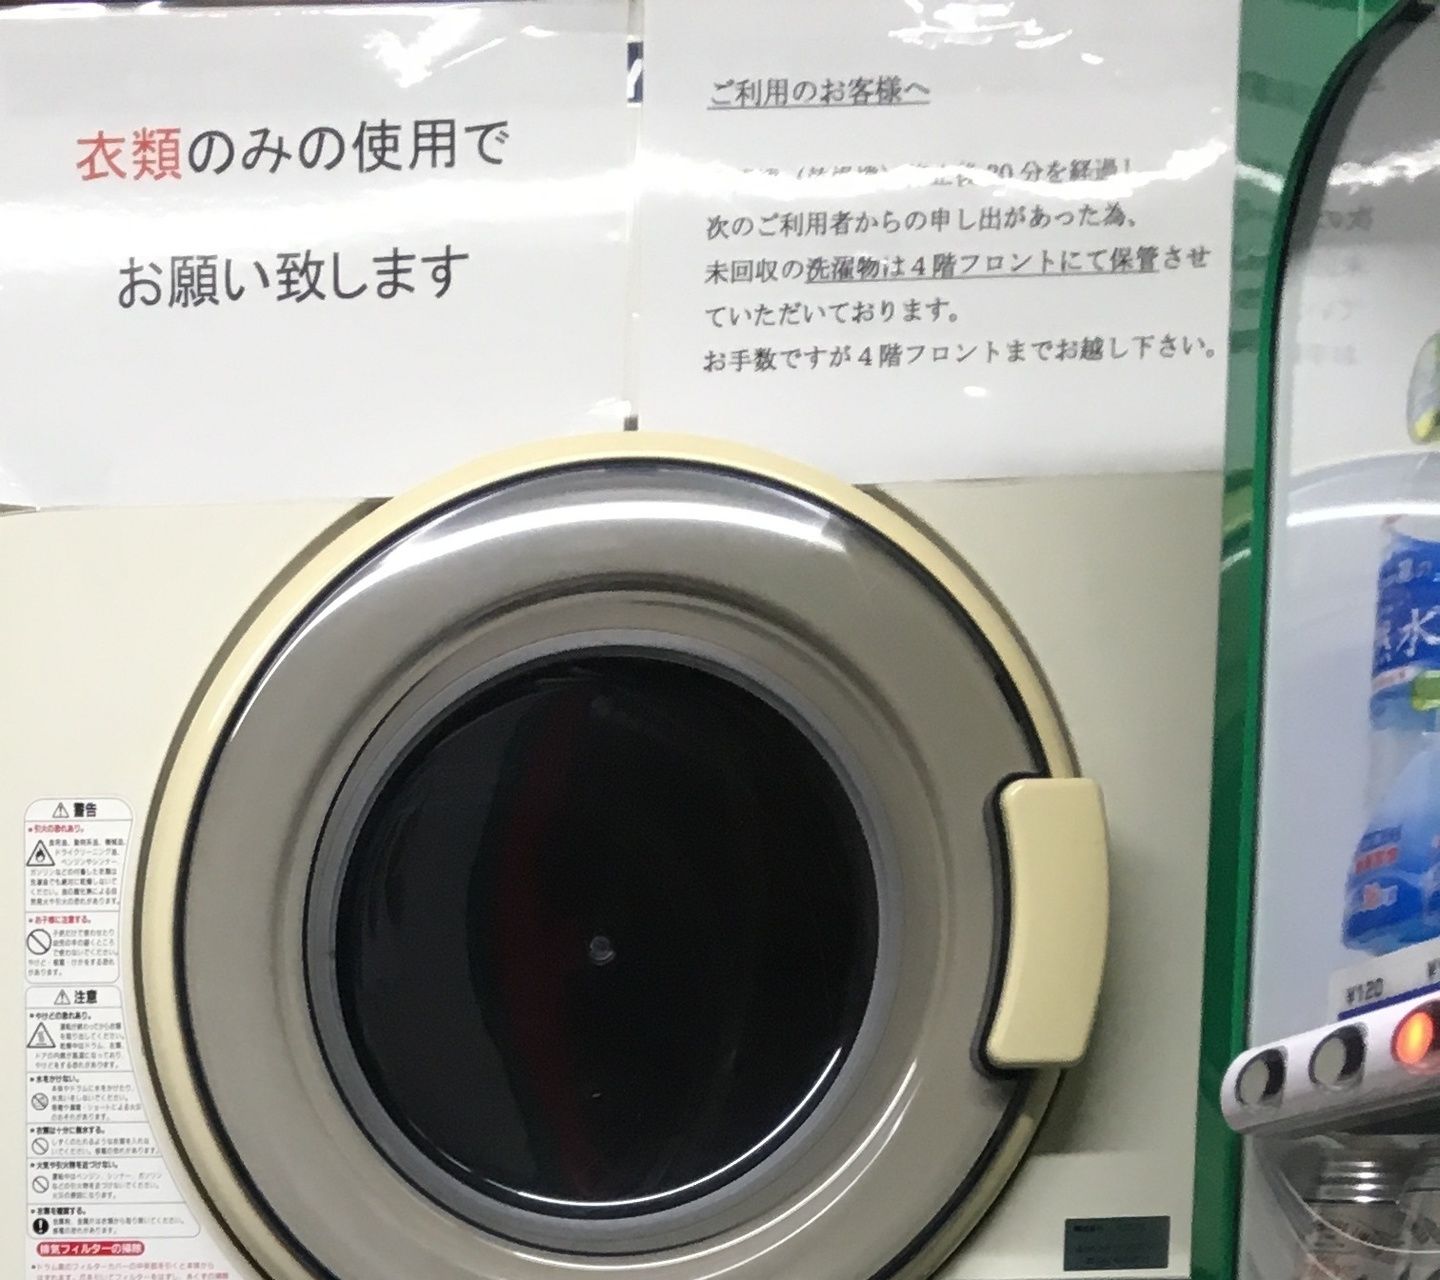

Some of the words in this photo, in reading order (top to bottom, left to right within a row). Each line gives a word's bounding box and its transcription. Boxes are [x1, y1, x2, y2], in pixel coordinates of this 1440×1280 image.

[711, 75, 931, 108] ご利用のお客様へ
[76, 119, 510, 181] 衣類のみの使用で
[705, 202, 1138, 241] 次のご利用者からの申し出があった為、
[118, 244, 470, 308] お願い致します
[704, 299, 960, 328] ていただいております。
[74, 802, 97, 817] 警告
[74, 990, 98, 1004] 注意
